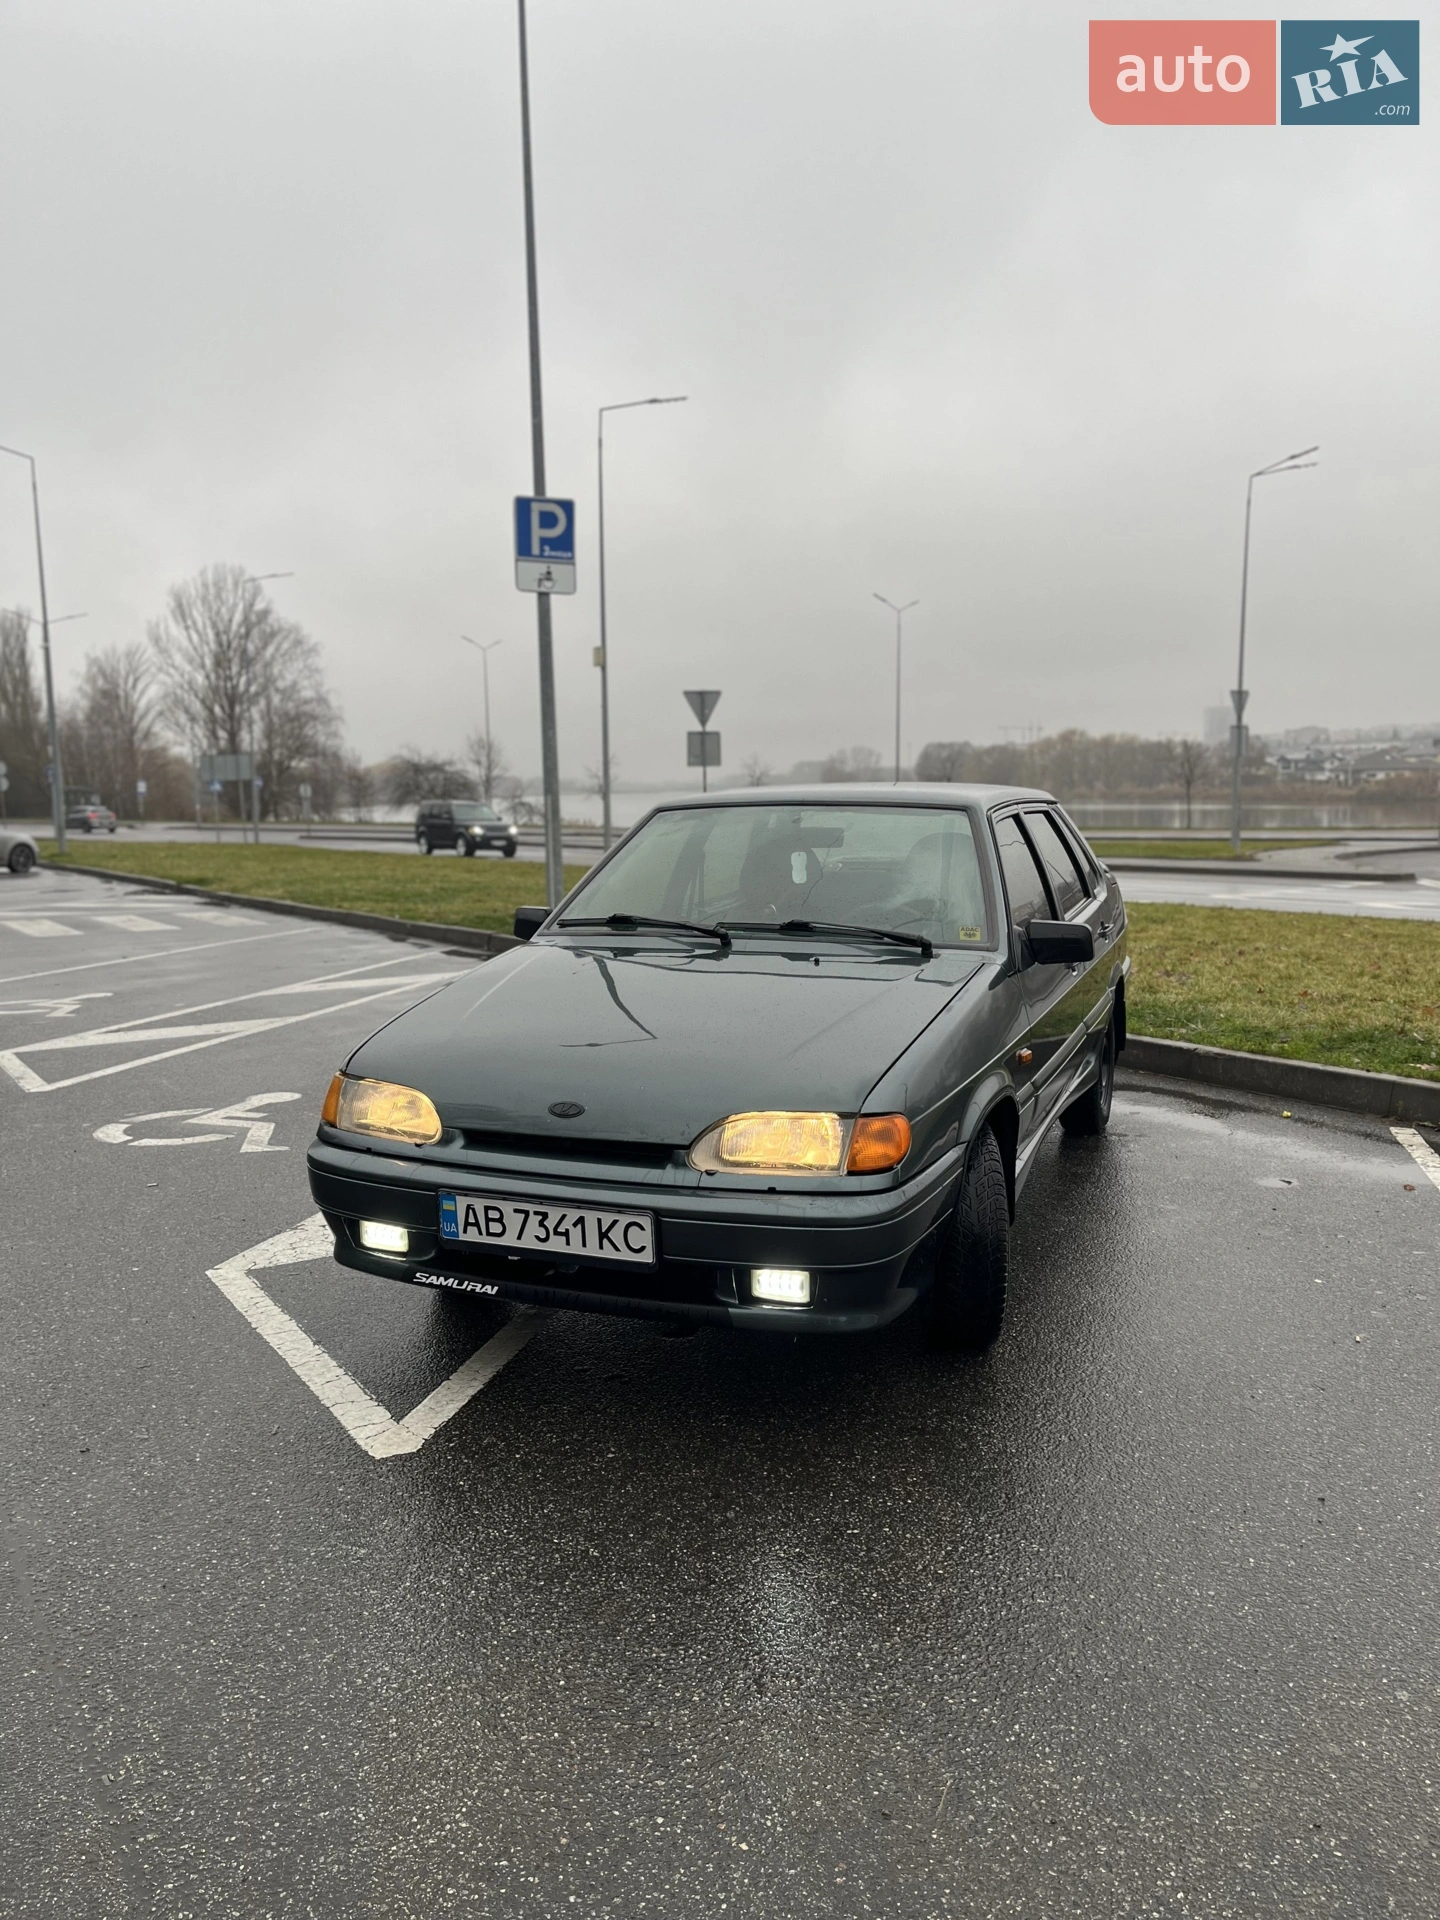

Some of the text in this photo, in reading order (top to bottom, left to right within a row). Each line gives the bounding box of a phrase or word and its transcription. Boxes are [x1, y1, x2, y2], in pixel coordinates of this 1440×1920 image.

[530, 501, 567, 556] P
[443, 1221, 457, 1233] UA
[512, 1207, 587, 1248] 7341
[413, 1272, 499, 1295] SAMURAI
